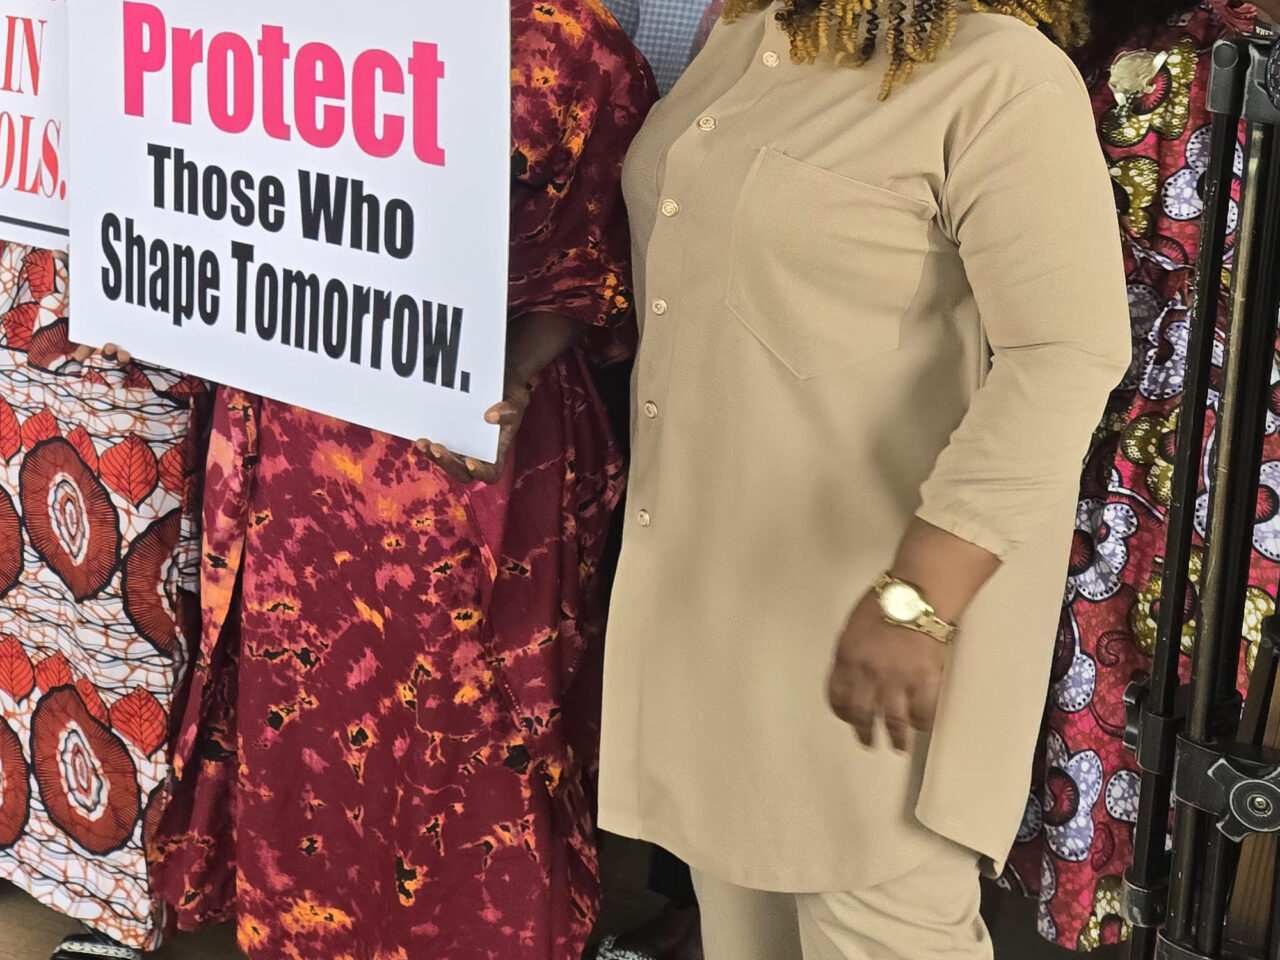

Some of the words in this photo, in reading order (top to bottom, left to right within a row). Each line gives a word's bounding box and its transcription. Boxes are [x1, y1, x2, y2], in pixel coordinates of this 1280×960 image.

[1, 15, 48, 97] IN
[123, 1, 446, 167] Protect
[147, 143, 285, 233] Those
[298, 169, 415, 260] Who
[101, 212, 220, 328] Shape
[231, 241, 471, 393] Tomorrow.
